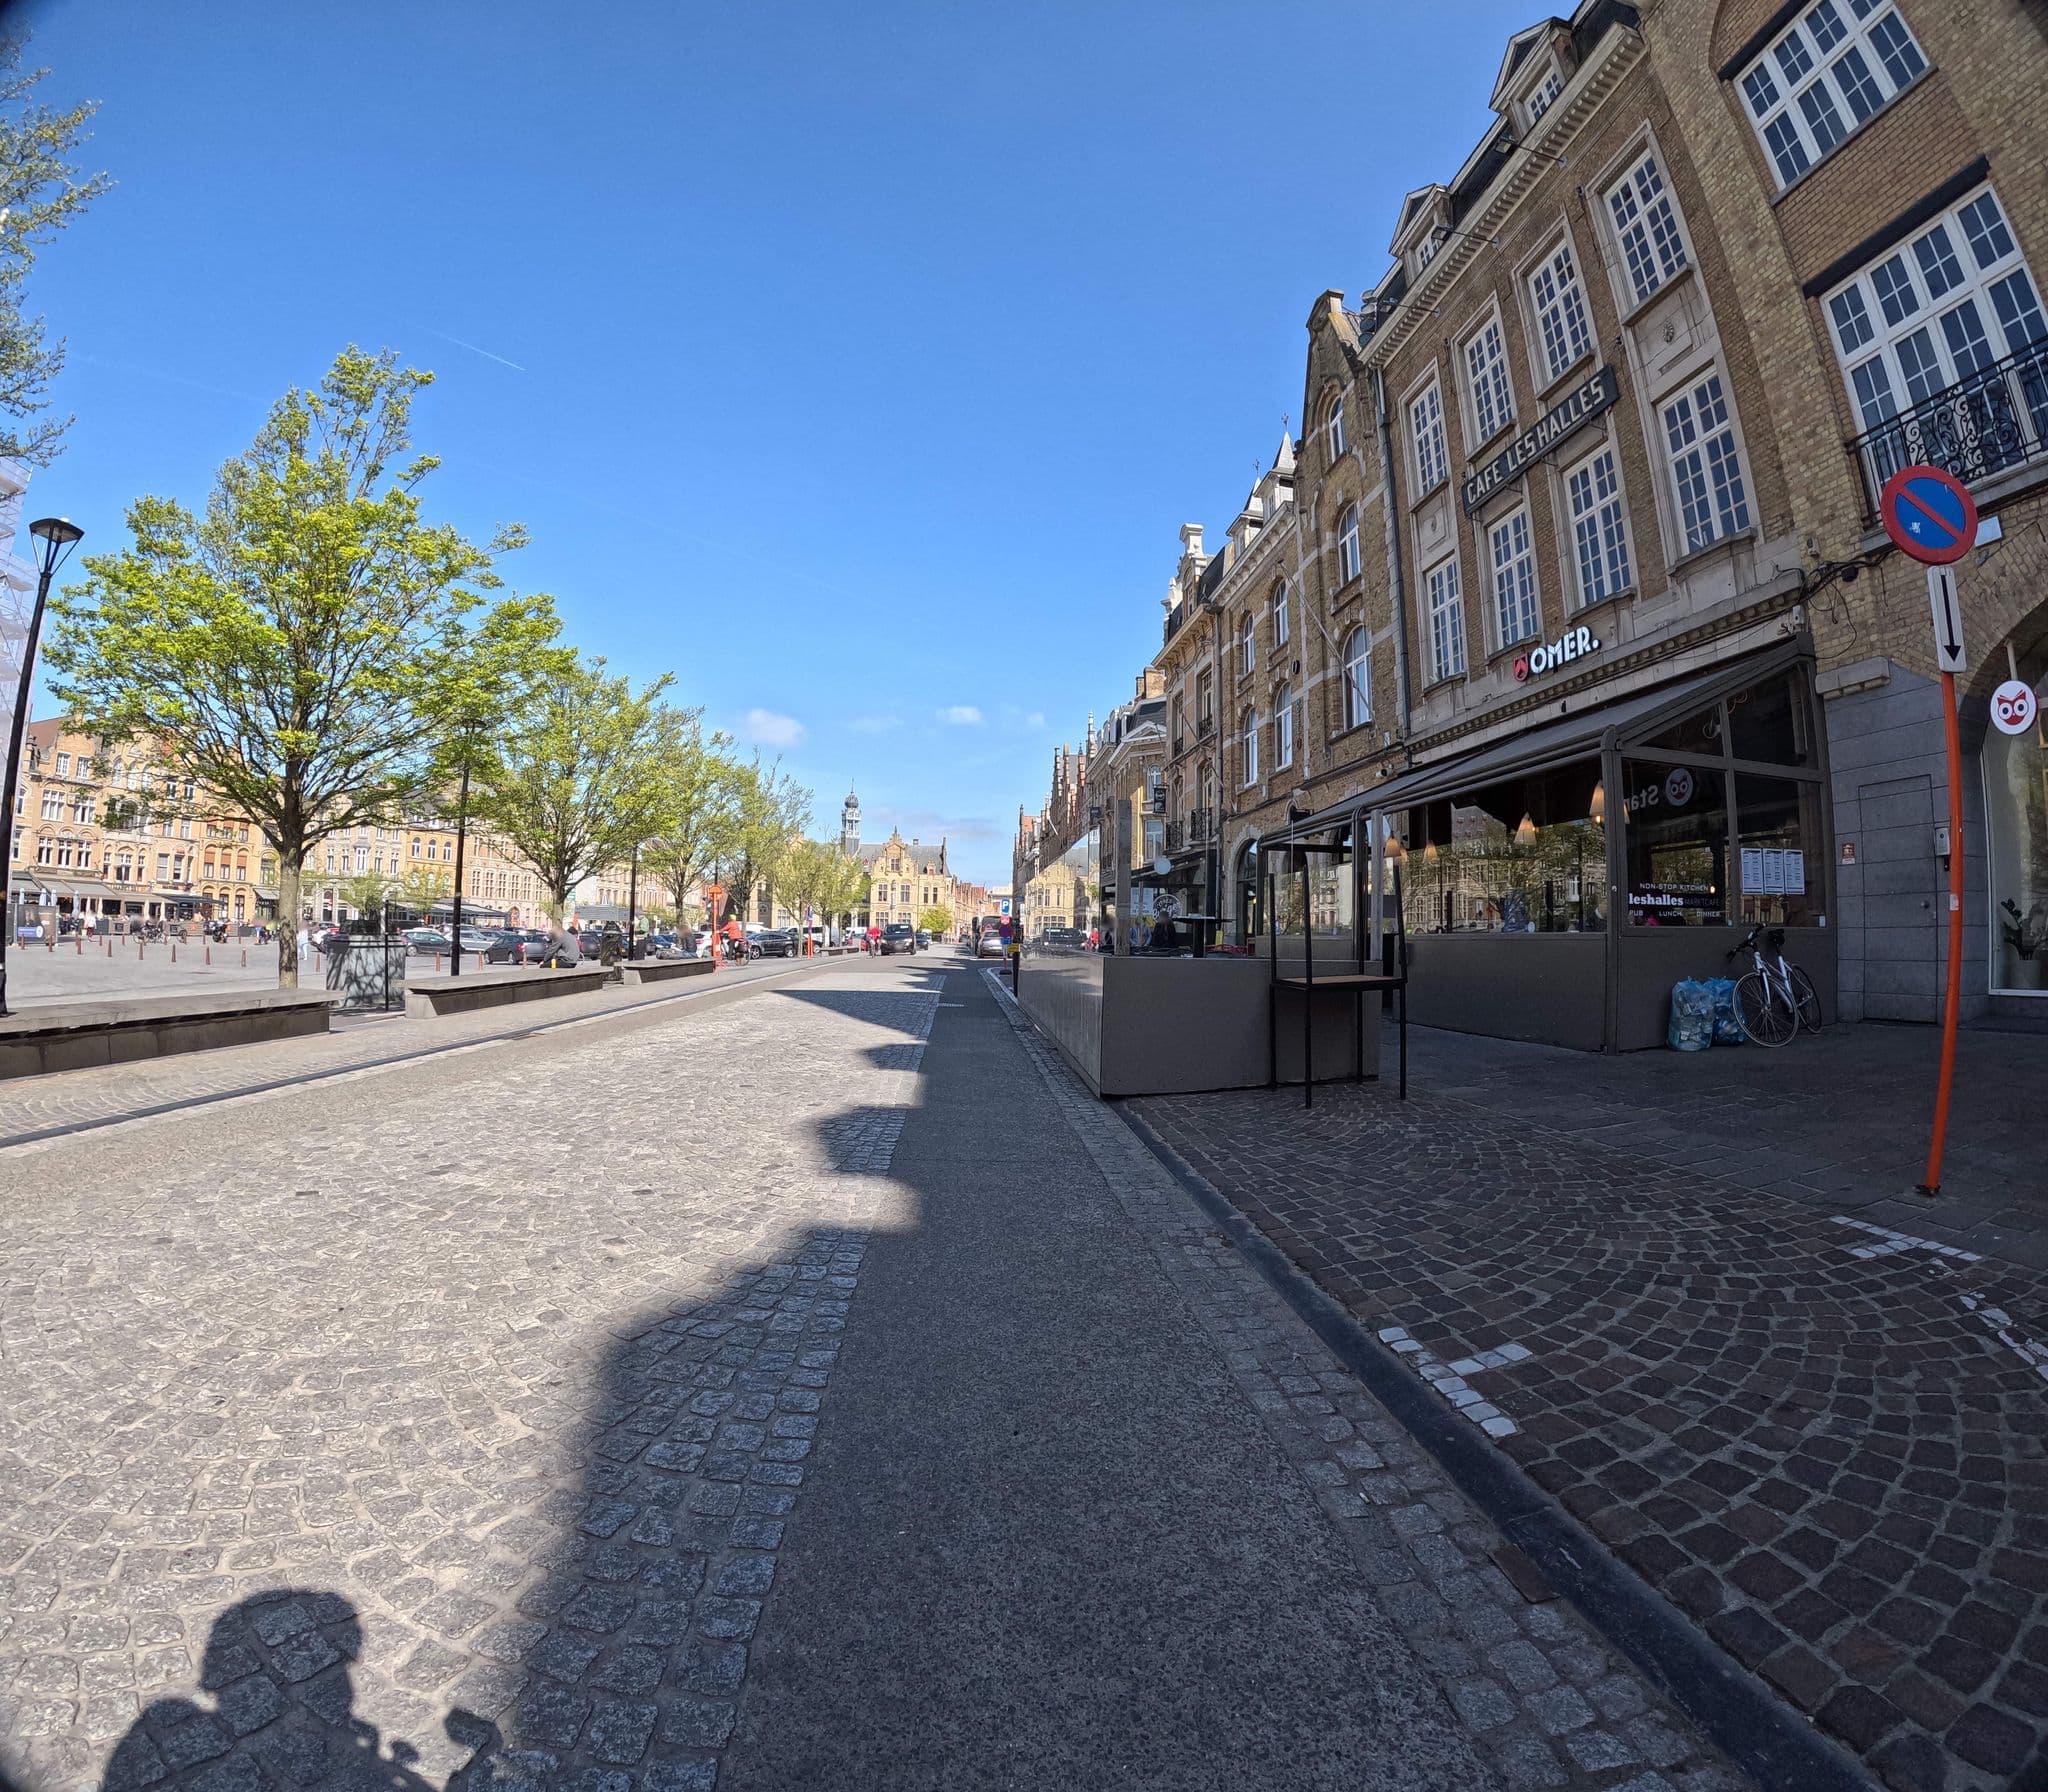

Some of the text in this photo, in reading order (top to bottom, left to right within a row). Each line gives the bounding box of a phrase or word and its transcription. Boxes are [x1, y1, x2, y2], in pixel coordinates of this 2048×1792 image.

[1466, 376, 1606, 504] CAFE LES HALLES
[1530, 626, 1600, 674] OMER.
[1639, 882, 1709, 892] NON-STOP KITCHEN
[1628, 893, 1684, 906] leshalles
[1628, 909, 1721, 918] PUB LUNCH DINNER
